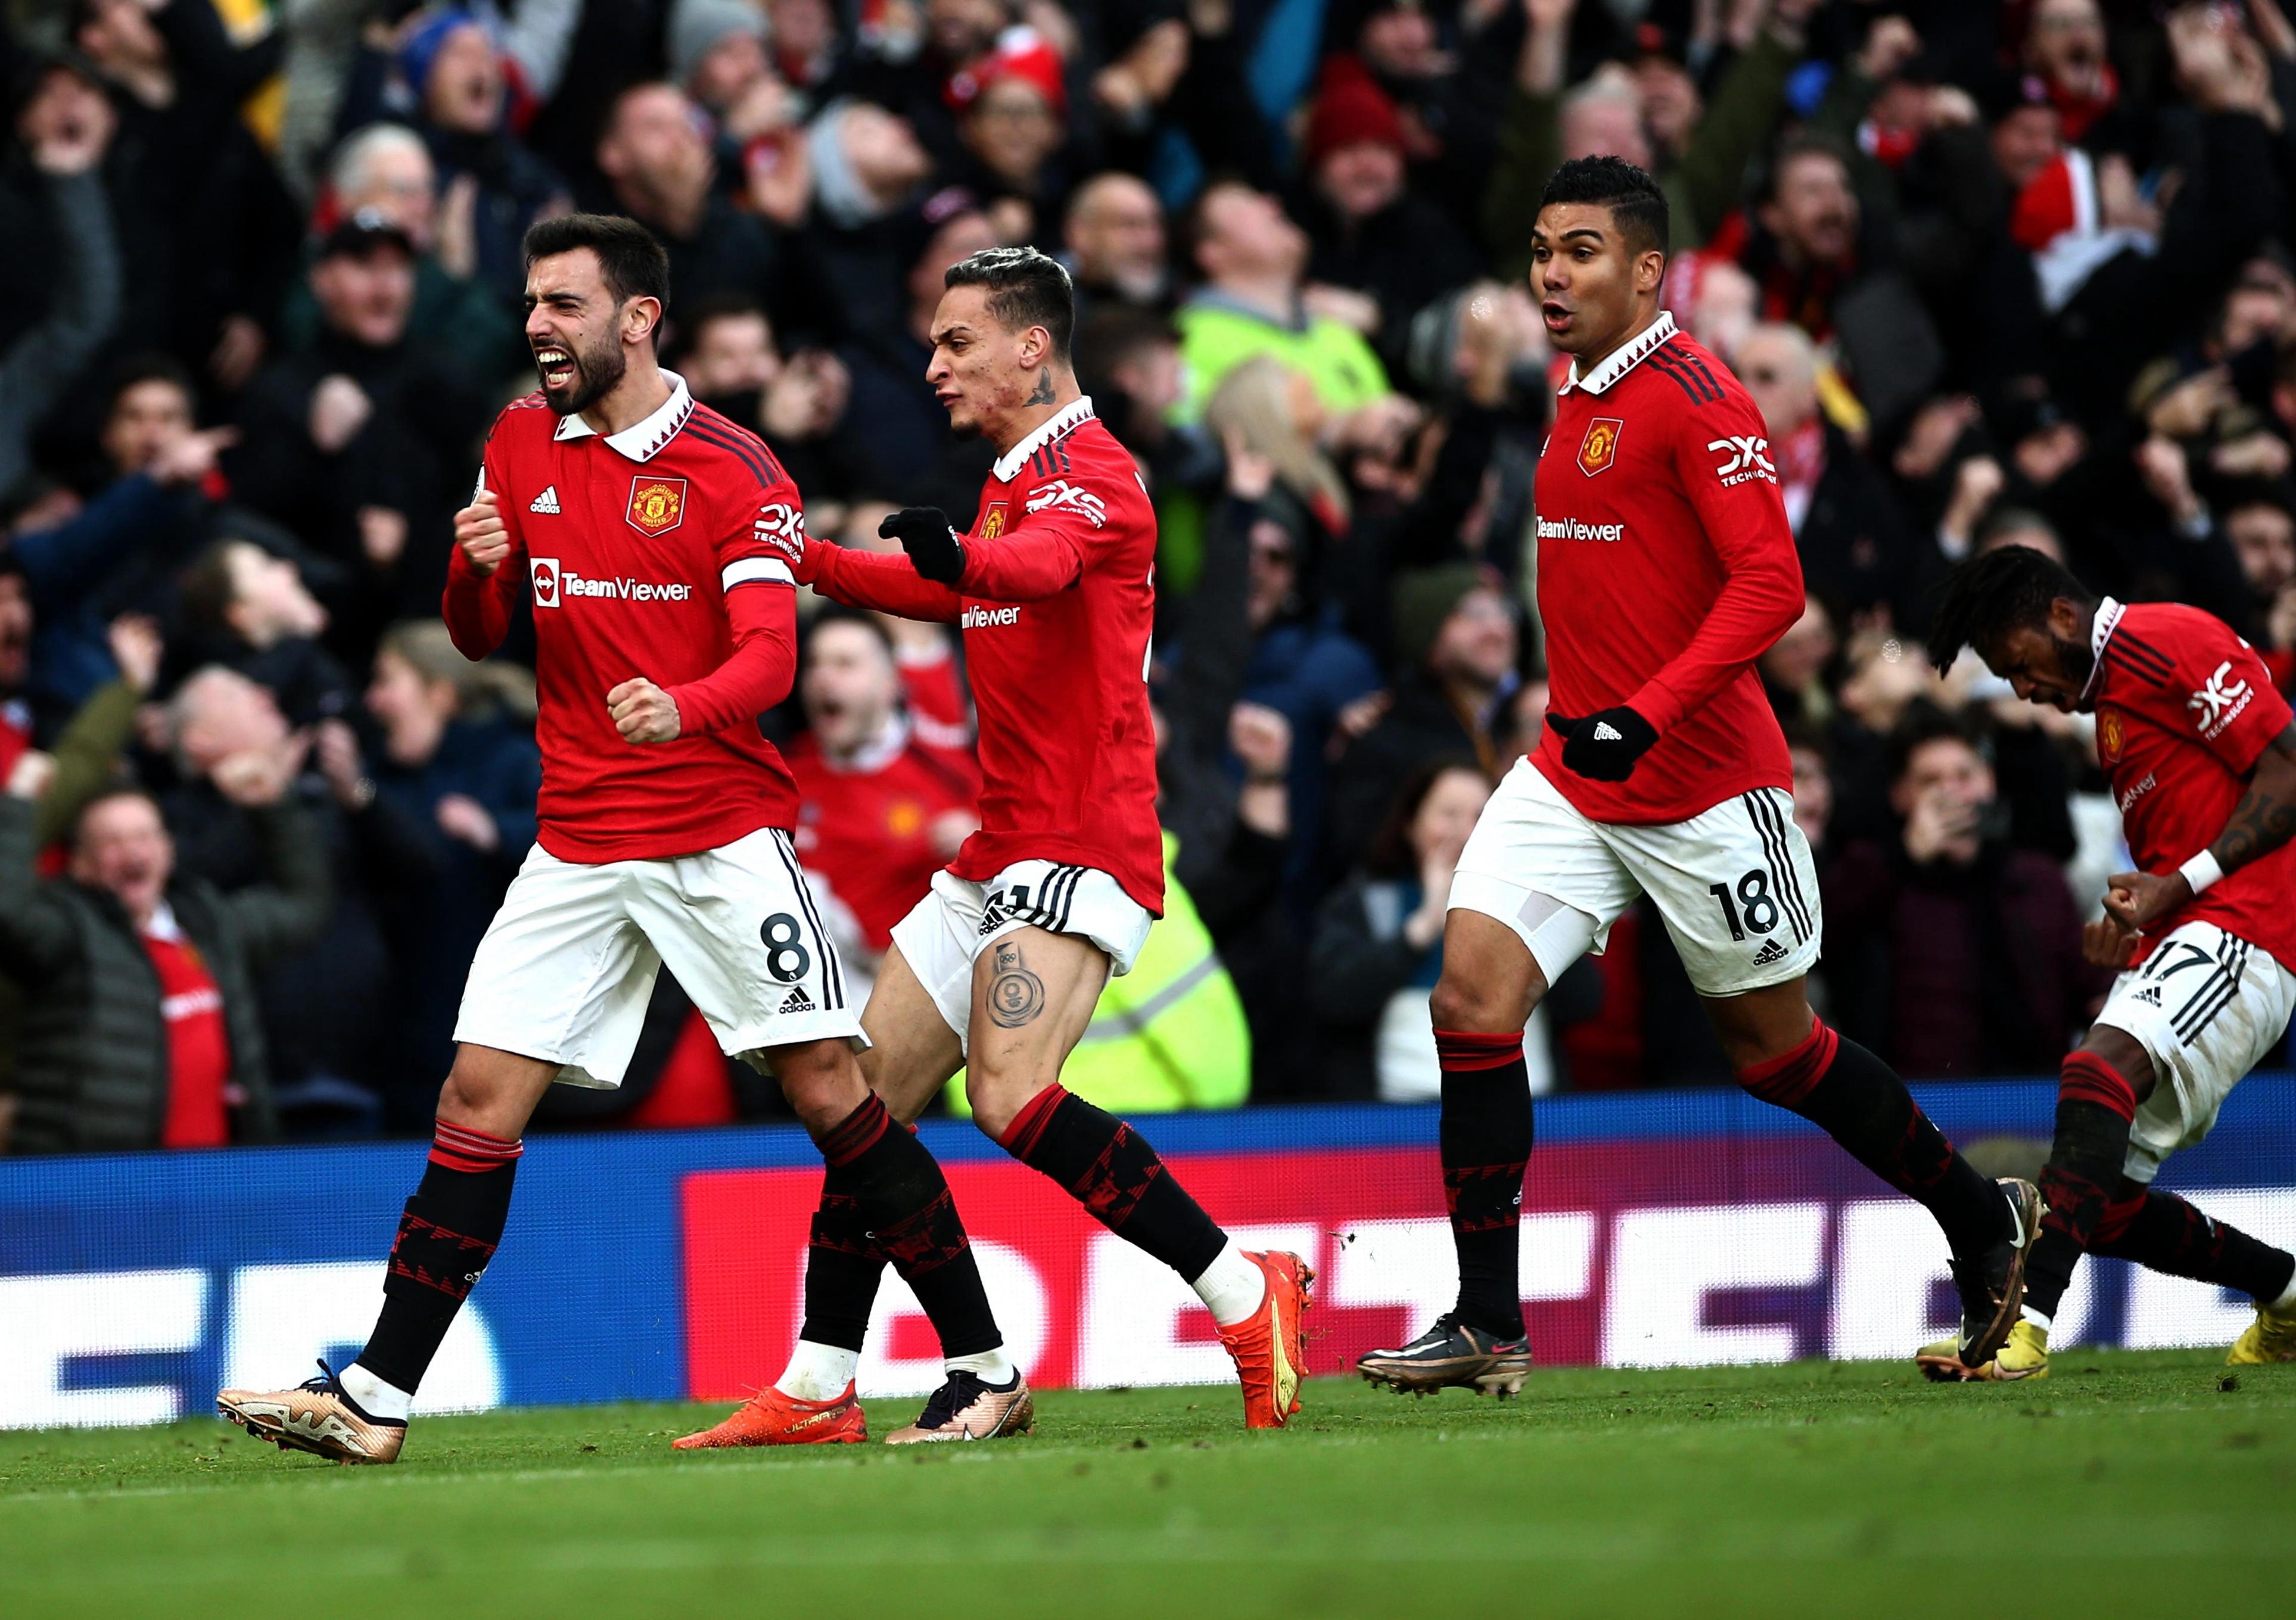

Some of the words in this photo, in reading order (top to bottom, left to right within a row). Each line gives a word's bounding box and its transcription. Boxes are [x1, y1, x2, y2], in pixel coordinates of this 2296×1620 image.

[530, 503, 560, 514] adidas
[1536, 516, 1624, 541] TeamViewer
[754, 531, 801, 564] TECHNOLOG
[561, 572, 692, 601] TeamViewer
[1709, 869, 1779, 942] 18
[760, 912, 810, 983] 8
[1753, 948, 1789, 966] adidas
[2141, 941, 2217, 982] 17
[779, 1002, 816, 1014] adidas
[784, 1412, 830, 1434] ULTRA
